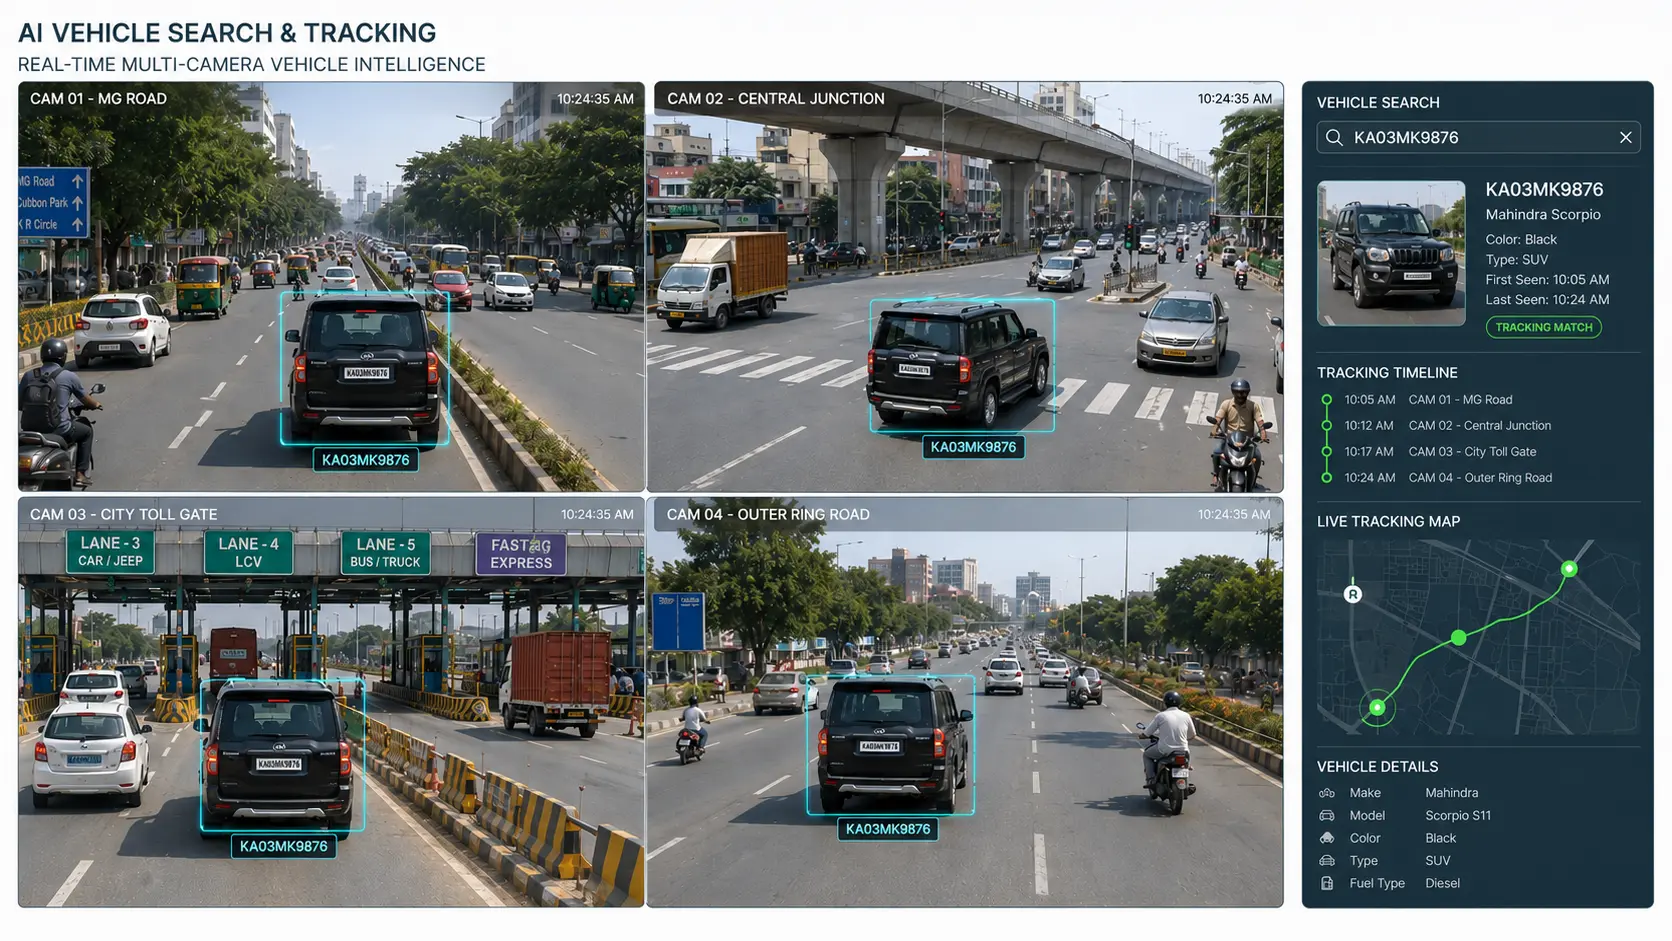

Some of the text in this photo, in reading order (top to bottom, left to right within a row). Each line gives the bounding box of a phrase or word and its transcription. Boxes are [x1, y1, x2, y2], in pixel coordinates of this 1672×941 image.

[33, 175, 54, 186] Road
[50, 197, 68, 207] Park
[26, 219, 31, 230] R
[34, 219, 57, 229] Circle
[82, 538, 120, 549] LANE
[133, 538, 140, 549] 3
[220, 538, 258, 550] LANE
[270, 538, 279, 550] 4
[358, 538, 395, 550] LANE
[408, 539, 415, 550] 5
[79, 555, 103, 565] CAR
[114, 556, 143, 566] JEEP
[236, 556, 262, 567] LCV
[351, 557, 373, 567] BUS
[383, 557, 420, 567] TRUCK
[491, 557, 552, 568] EXPRESS
